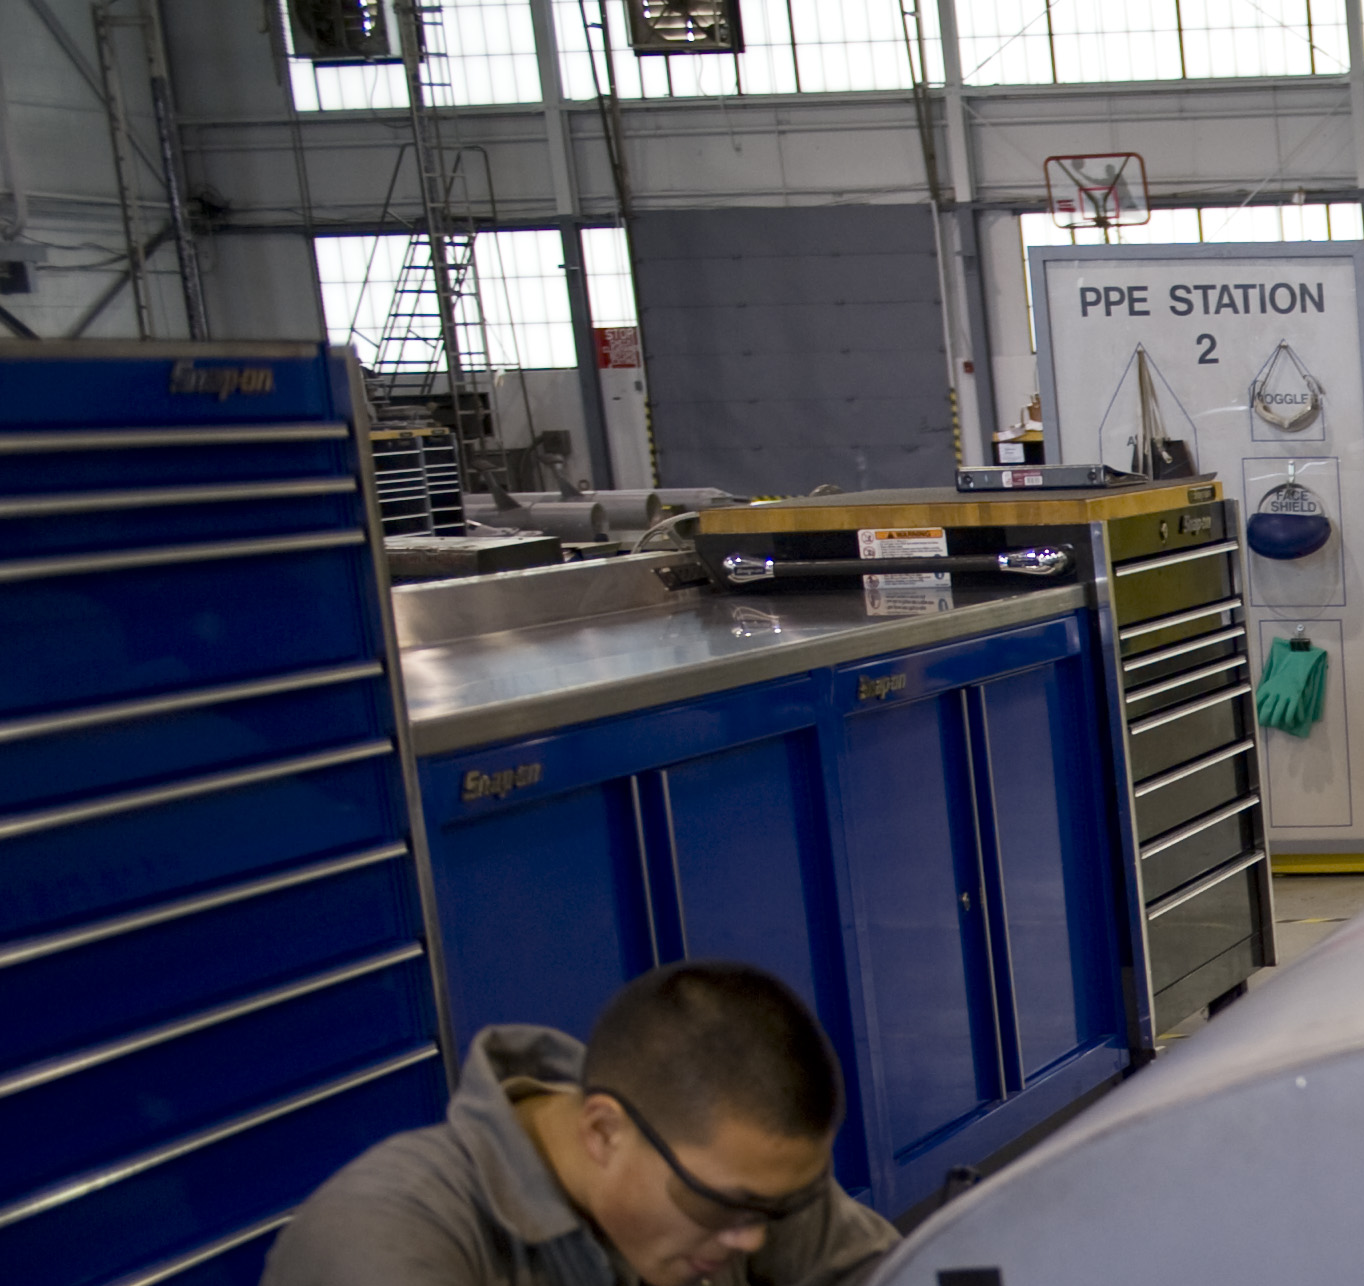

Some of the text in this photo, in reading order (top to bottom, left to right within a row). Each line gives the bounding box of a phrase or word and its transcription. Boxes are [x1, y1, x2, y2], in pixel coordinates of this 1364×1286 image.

[1080, 282, 1325, 317] PPE STATION
[1196, 333, 1219, 364] 2
[1258, 393, 1310, 405] OGGLE
[1276, 490, 1309, 501] FACE
[1271, 501, 1317, 513] SHIELD
[460, 762, 542, 801] Snap-on
